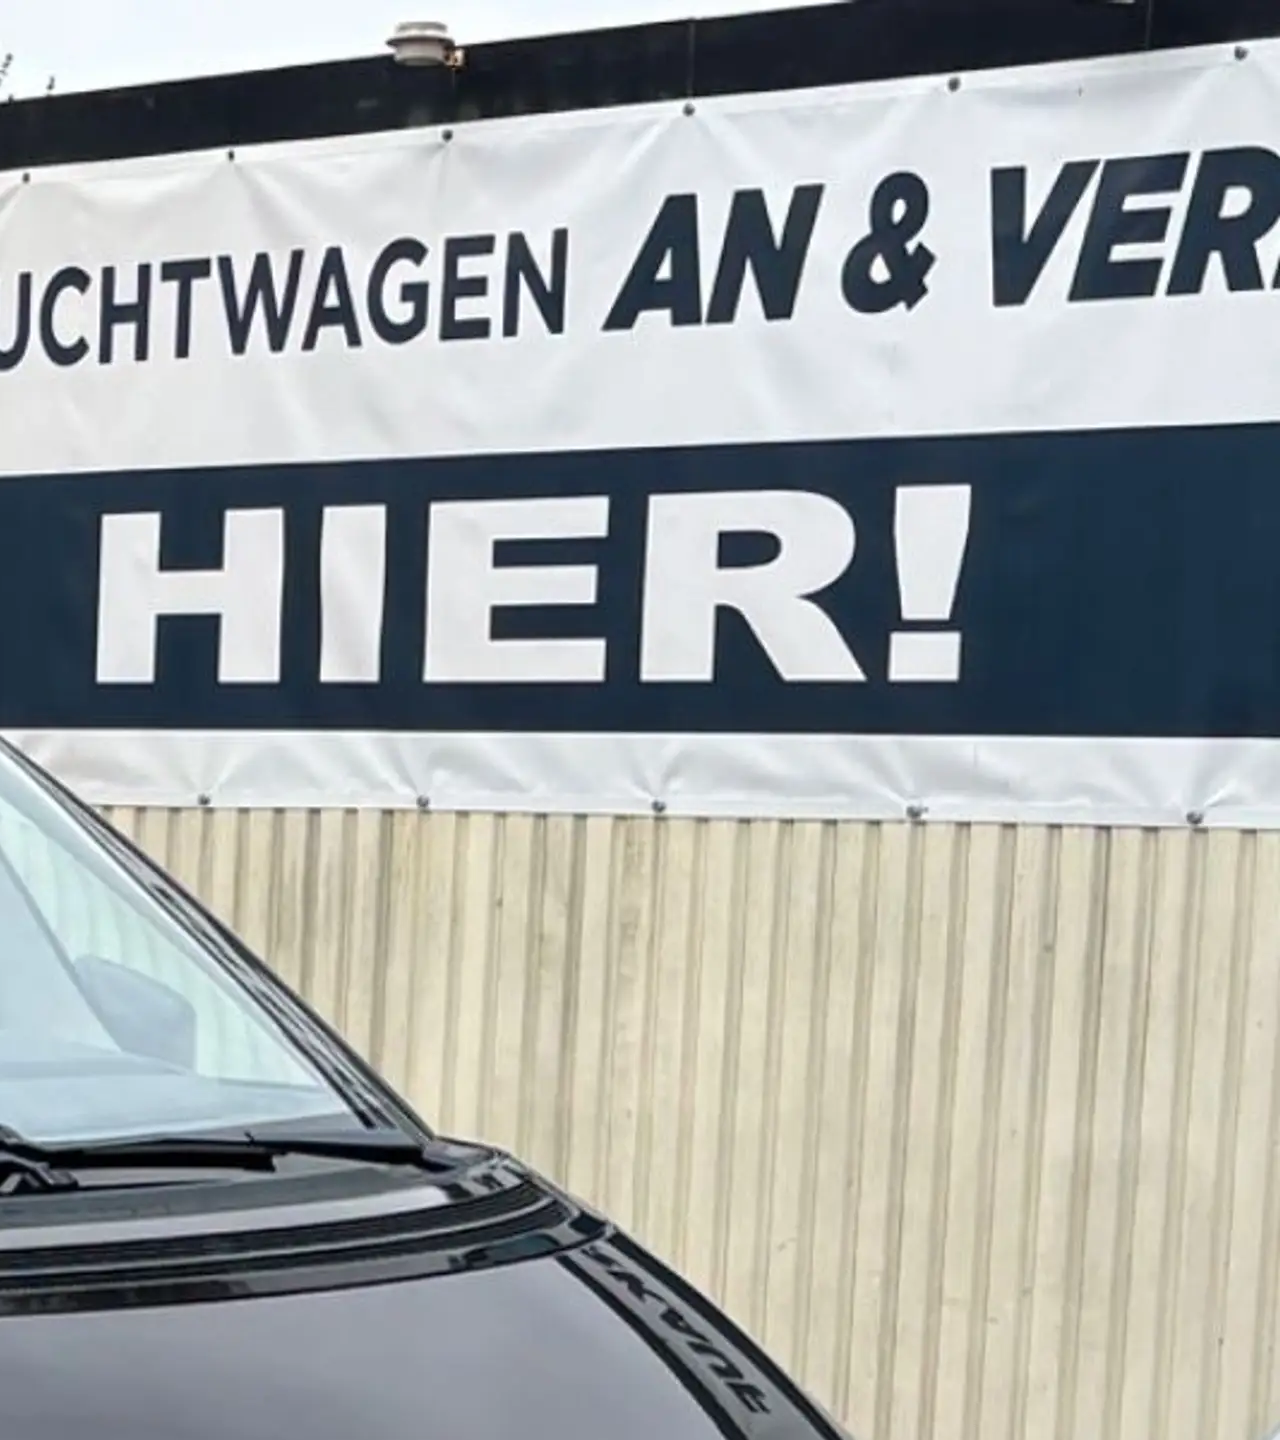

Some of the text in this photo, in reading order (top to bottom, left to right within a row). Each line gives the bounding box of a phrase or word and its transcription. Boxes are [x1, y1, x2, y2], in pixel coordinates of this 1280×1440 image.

[601, 183, 826, 332] AN
[841, 171, 937, 313] &
[989, 145, 1280, 308] VER
[95, 483, 973, 684] HIER!
